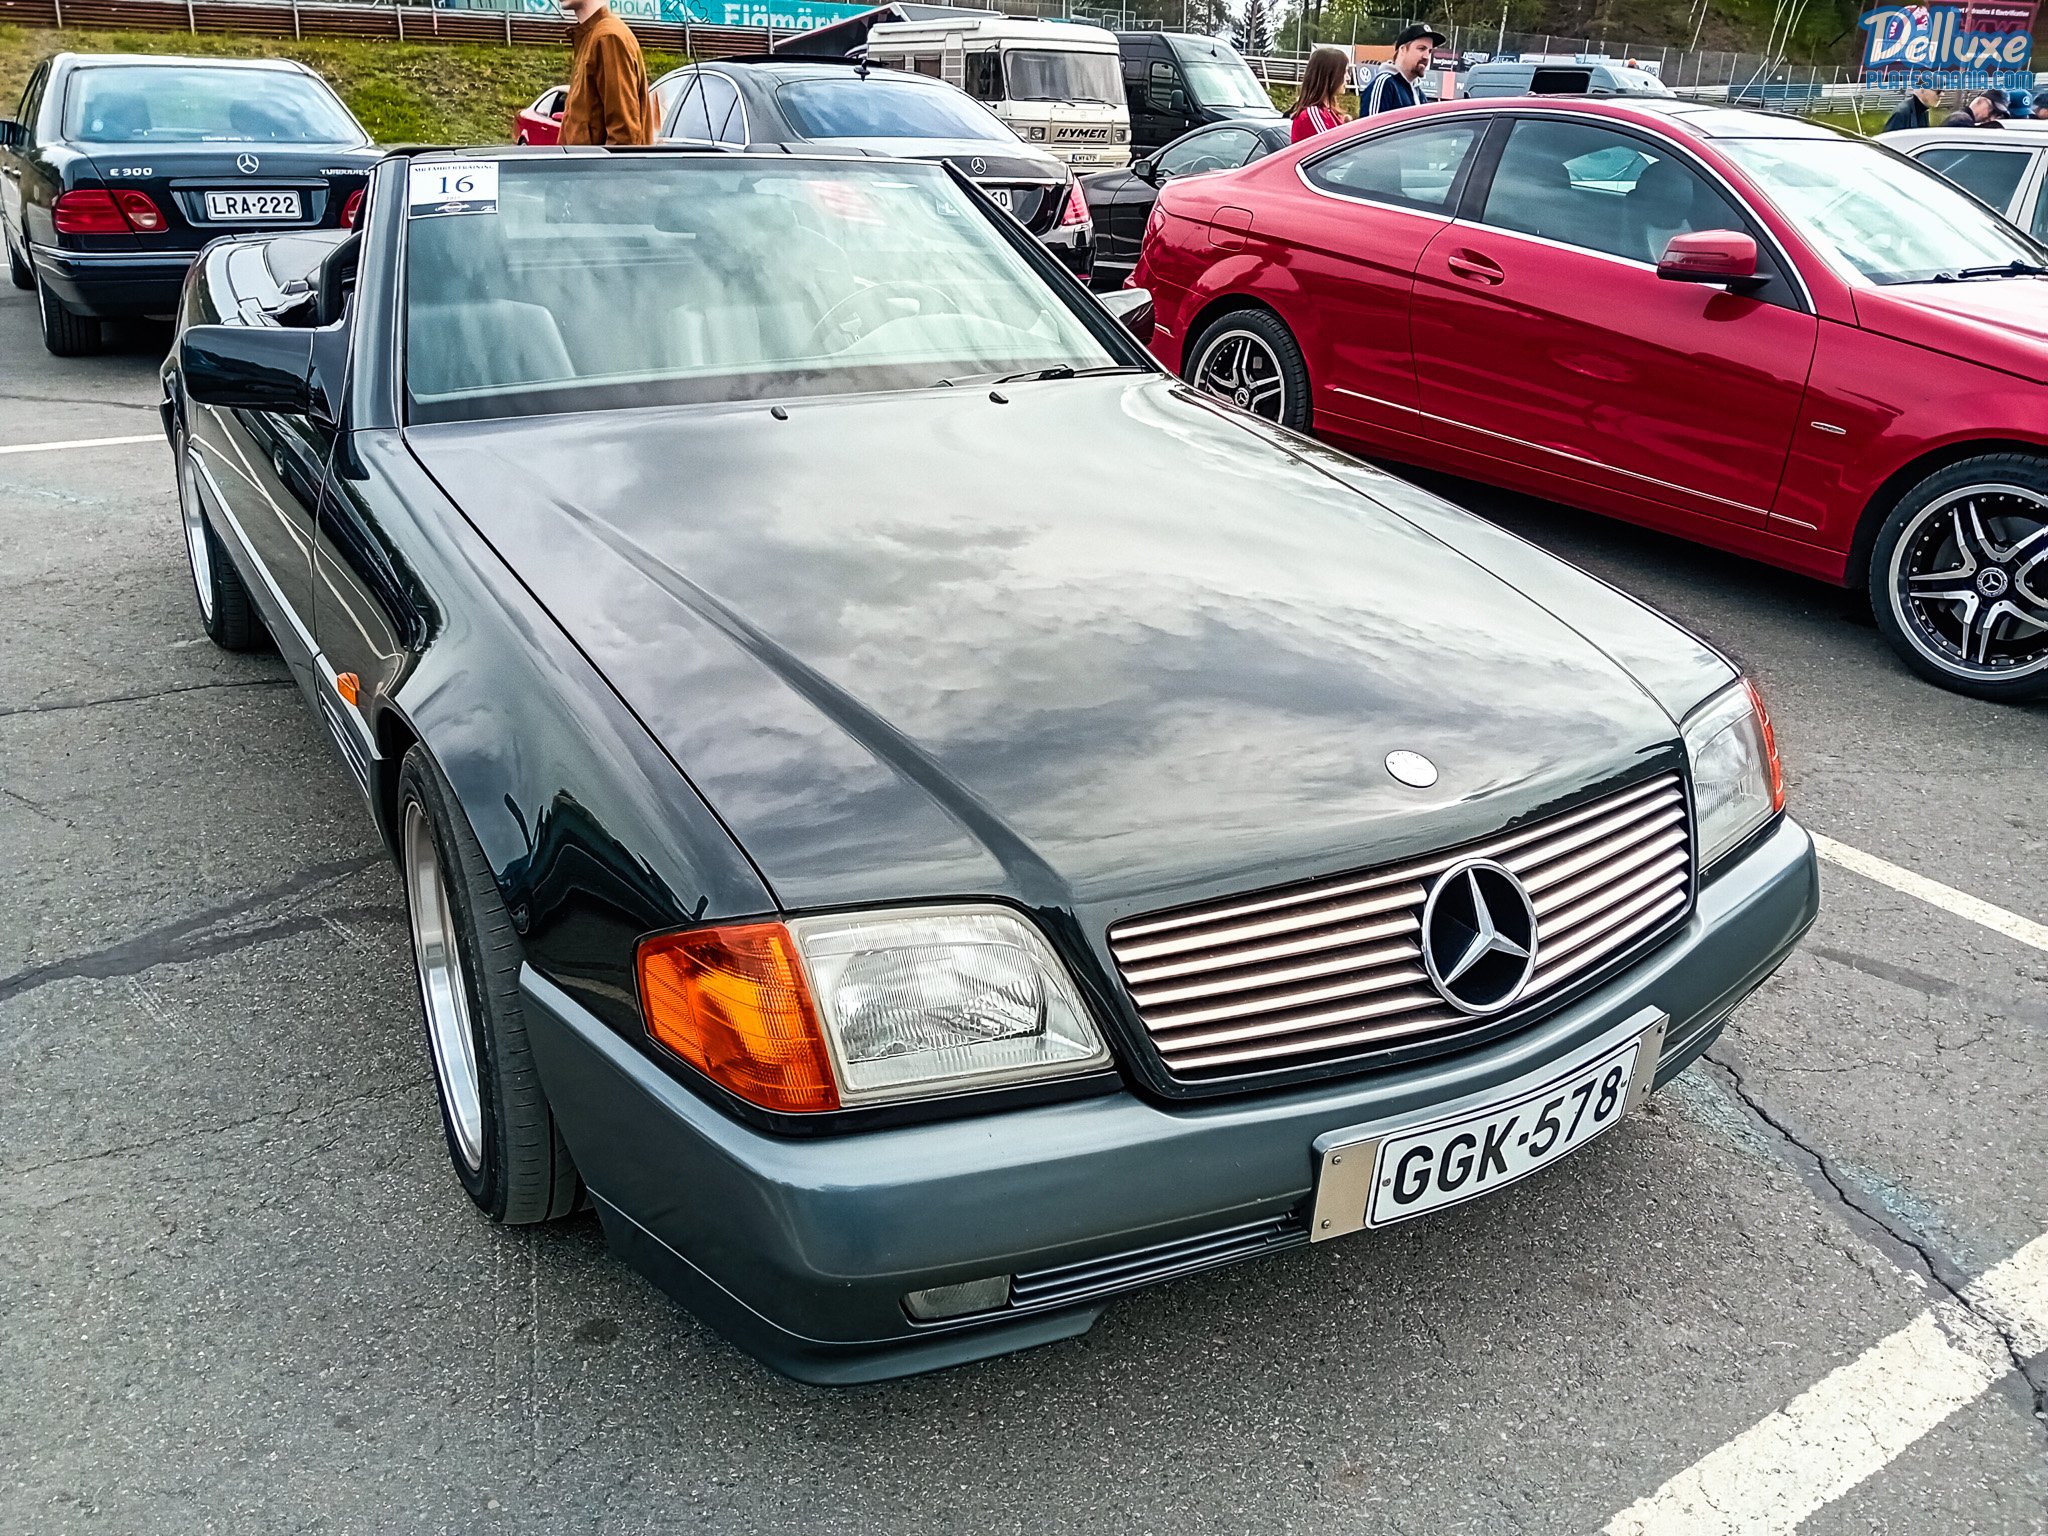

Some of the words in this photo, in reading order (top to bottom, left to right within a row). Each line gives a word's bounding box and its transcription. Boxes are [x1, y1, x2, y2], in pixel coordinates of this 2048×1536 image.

[1057, 128, 1109, 139] HYMER
[109, 168, 120, 177] E
[122, 167, 153, 177] 300
[438, 174, 475, 195] 16
[211, 196, 296, 215] LRA-222
[1391, 1065, 1624, 1205] GGK-578
